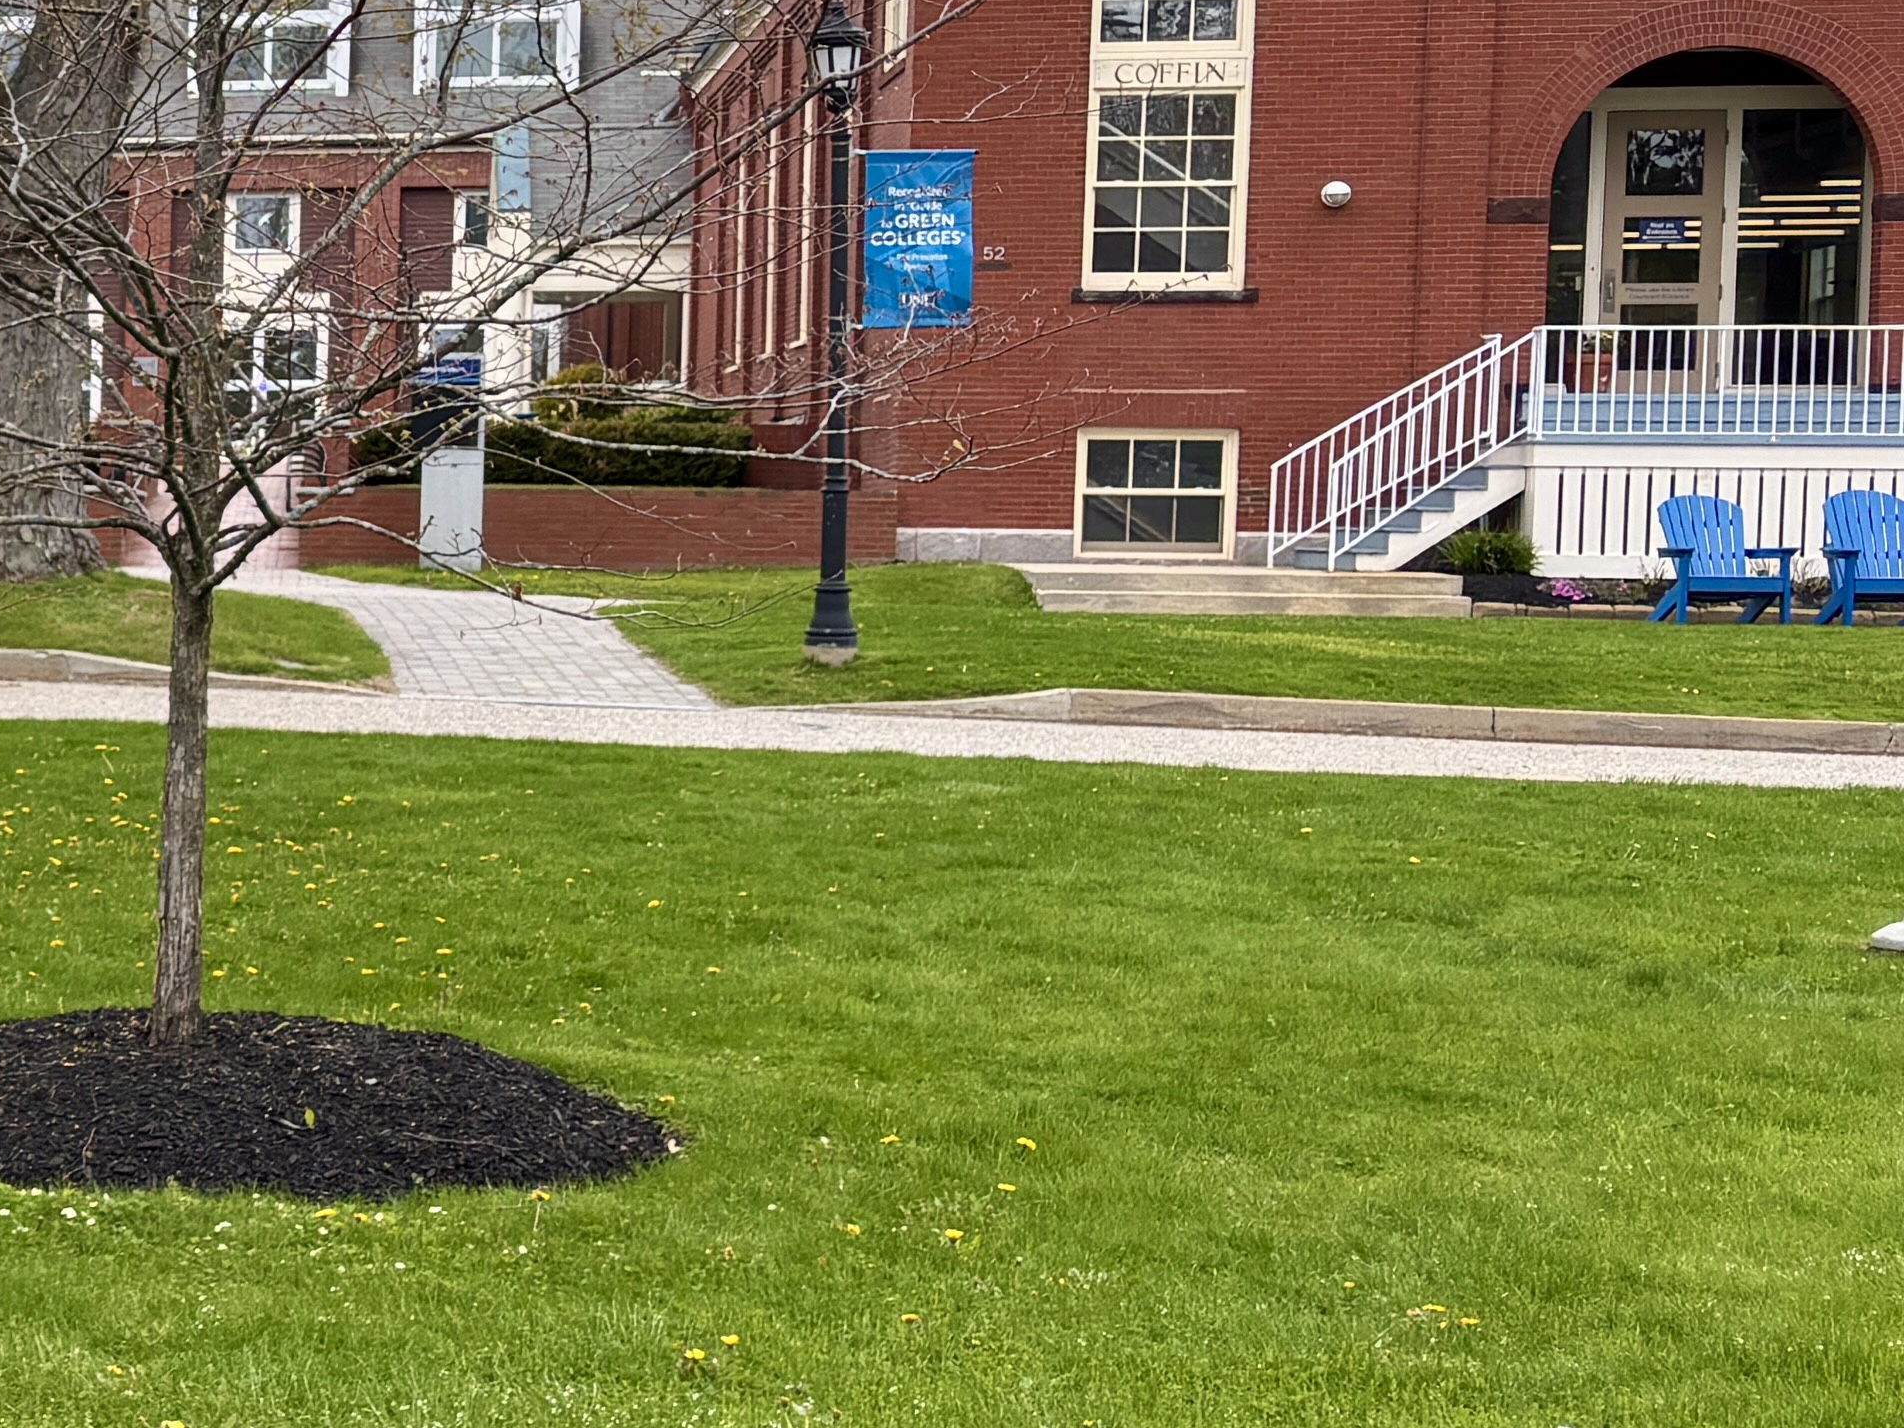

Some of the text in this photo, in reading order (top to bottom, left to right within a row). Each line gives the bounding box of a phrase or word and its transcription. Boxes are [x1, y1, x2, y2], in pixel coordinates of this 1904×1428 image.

[1114, 61, 1227, 84] COFFIN
[895, 213, 955, 230] GREEN
[983, 246, 1005, 261] 52
